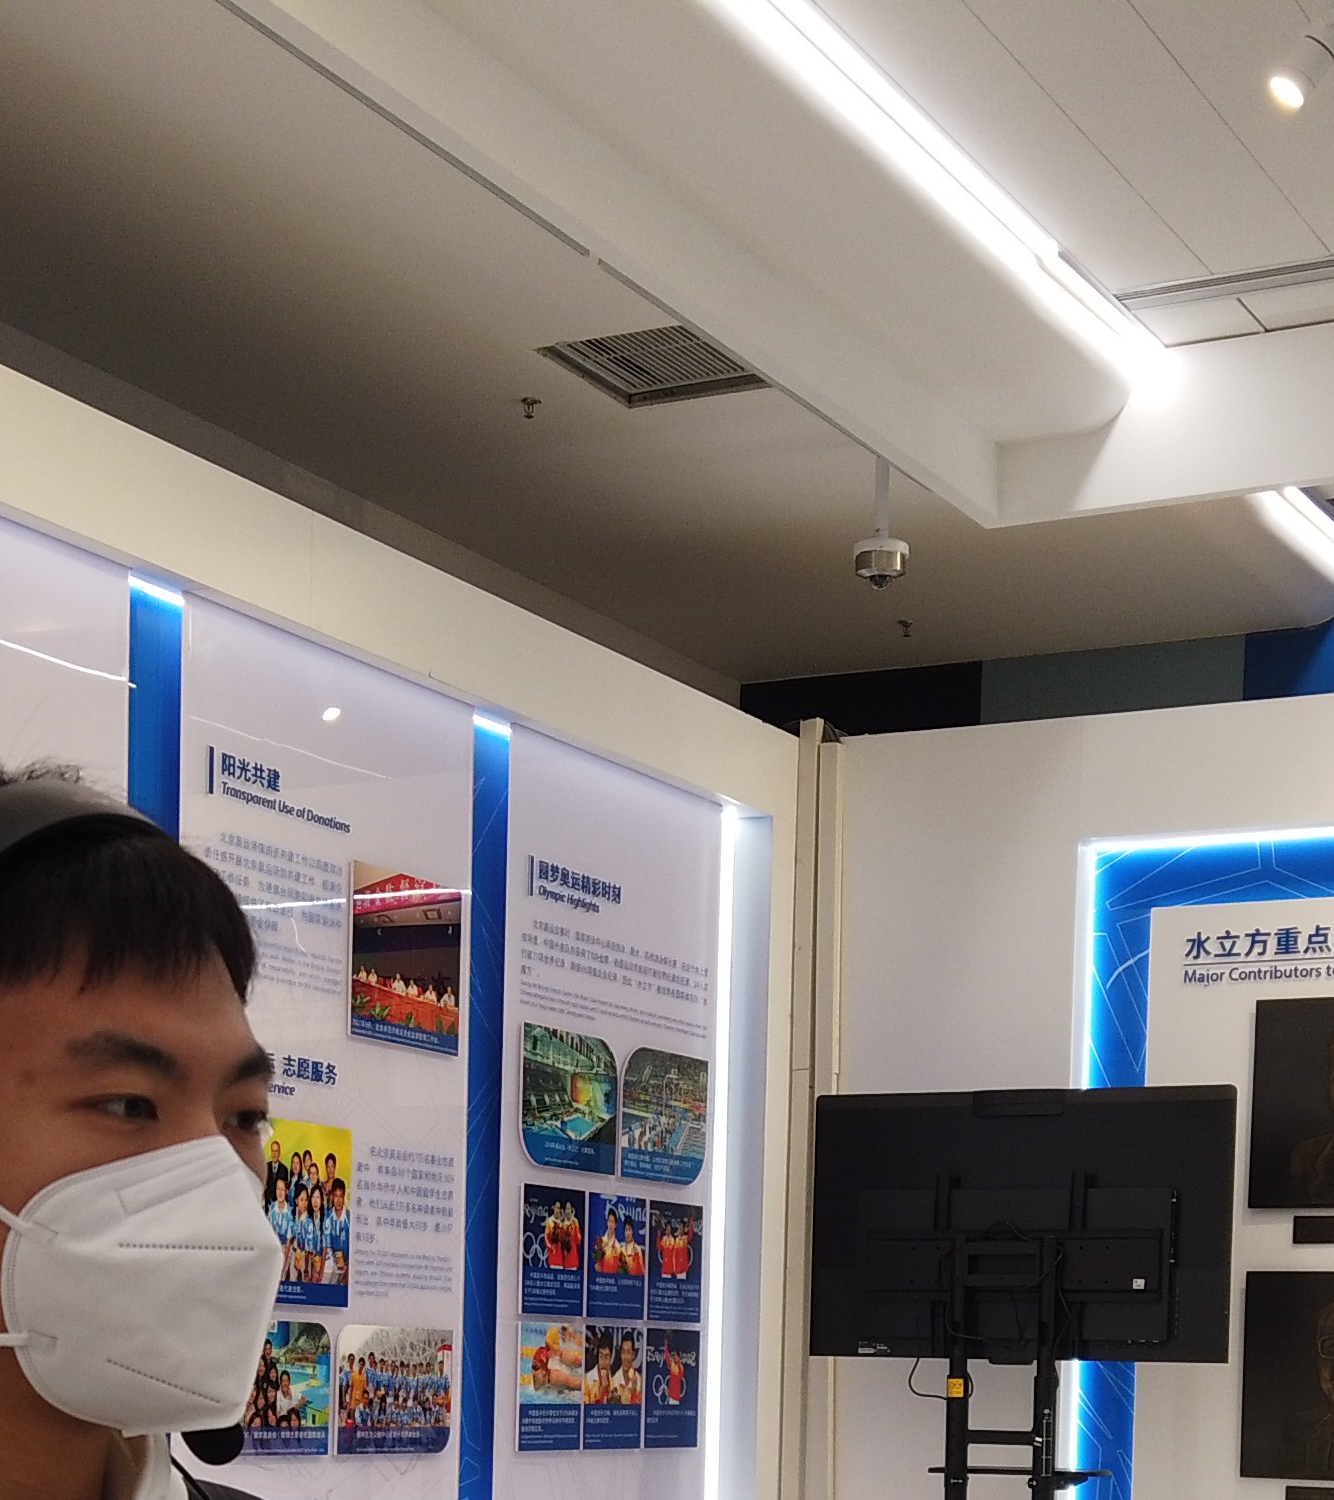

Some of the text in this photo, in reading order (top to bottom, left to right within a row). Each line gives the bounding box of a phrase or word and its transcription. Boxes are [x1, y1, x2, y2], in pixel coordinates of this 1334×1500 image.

[221, 752, 281, 793] 阳光共建
[221, 782, 352, 834] Transparent Use of Donations
[538, 860, 622, 904] 圆梦奥运精彩时刻
[538, 884, 600, 914] Olympic Highlights
[1183, 969, 1225, 987] Major
[1228, 966, 1322, 982] Contributors
[282, 1055, 338, 1086] 志愿服务
